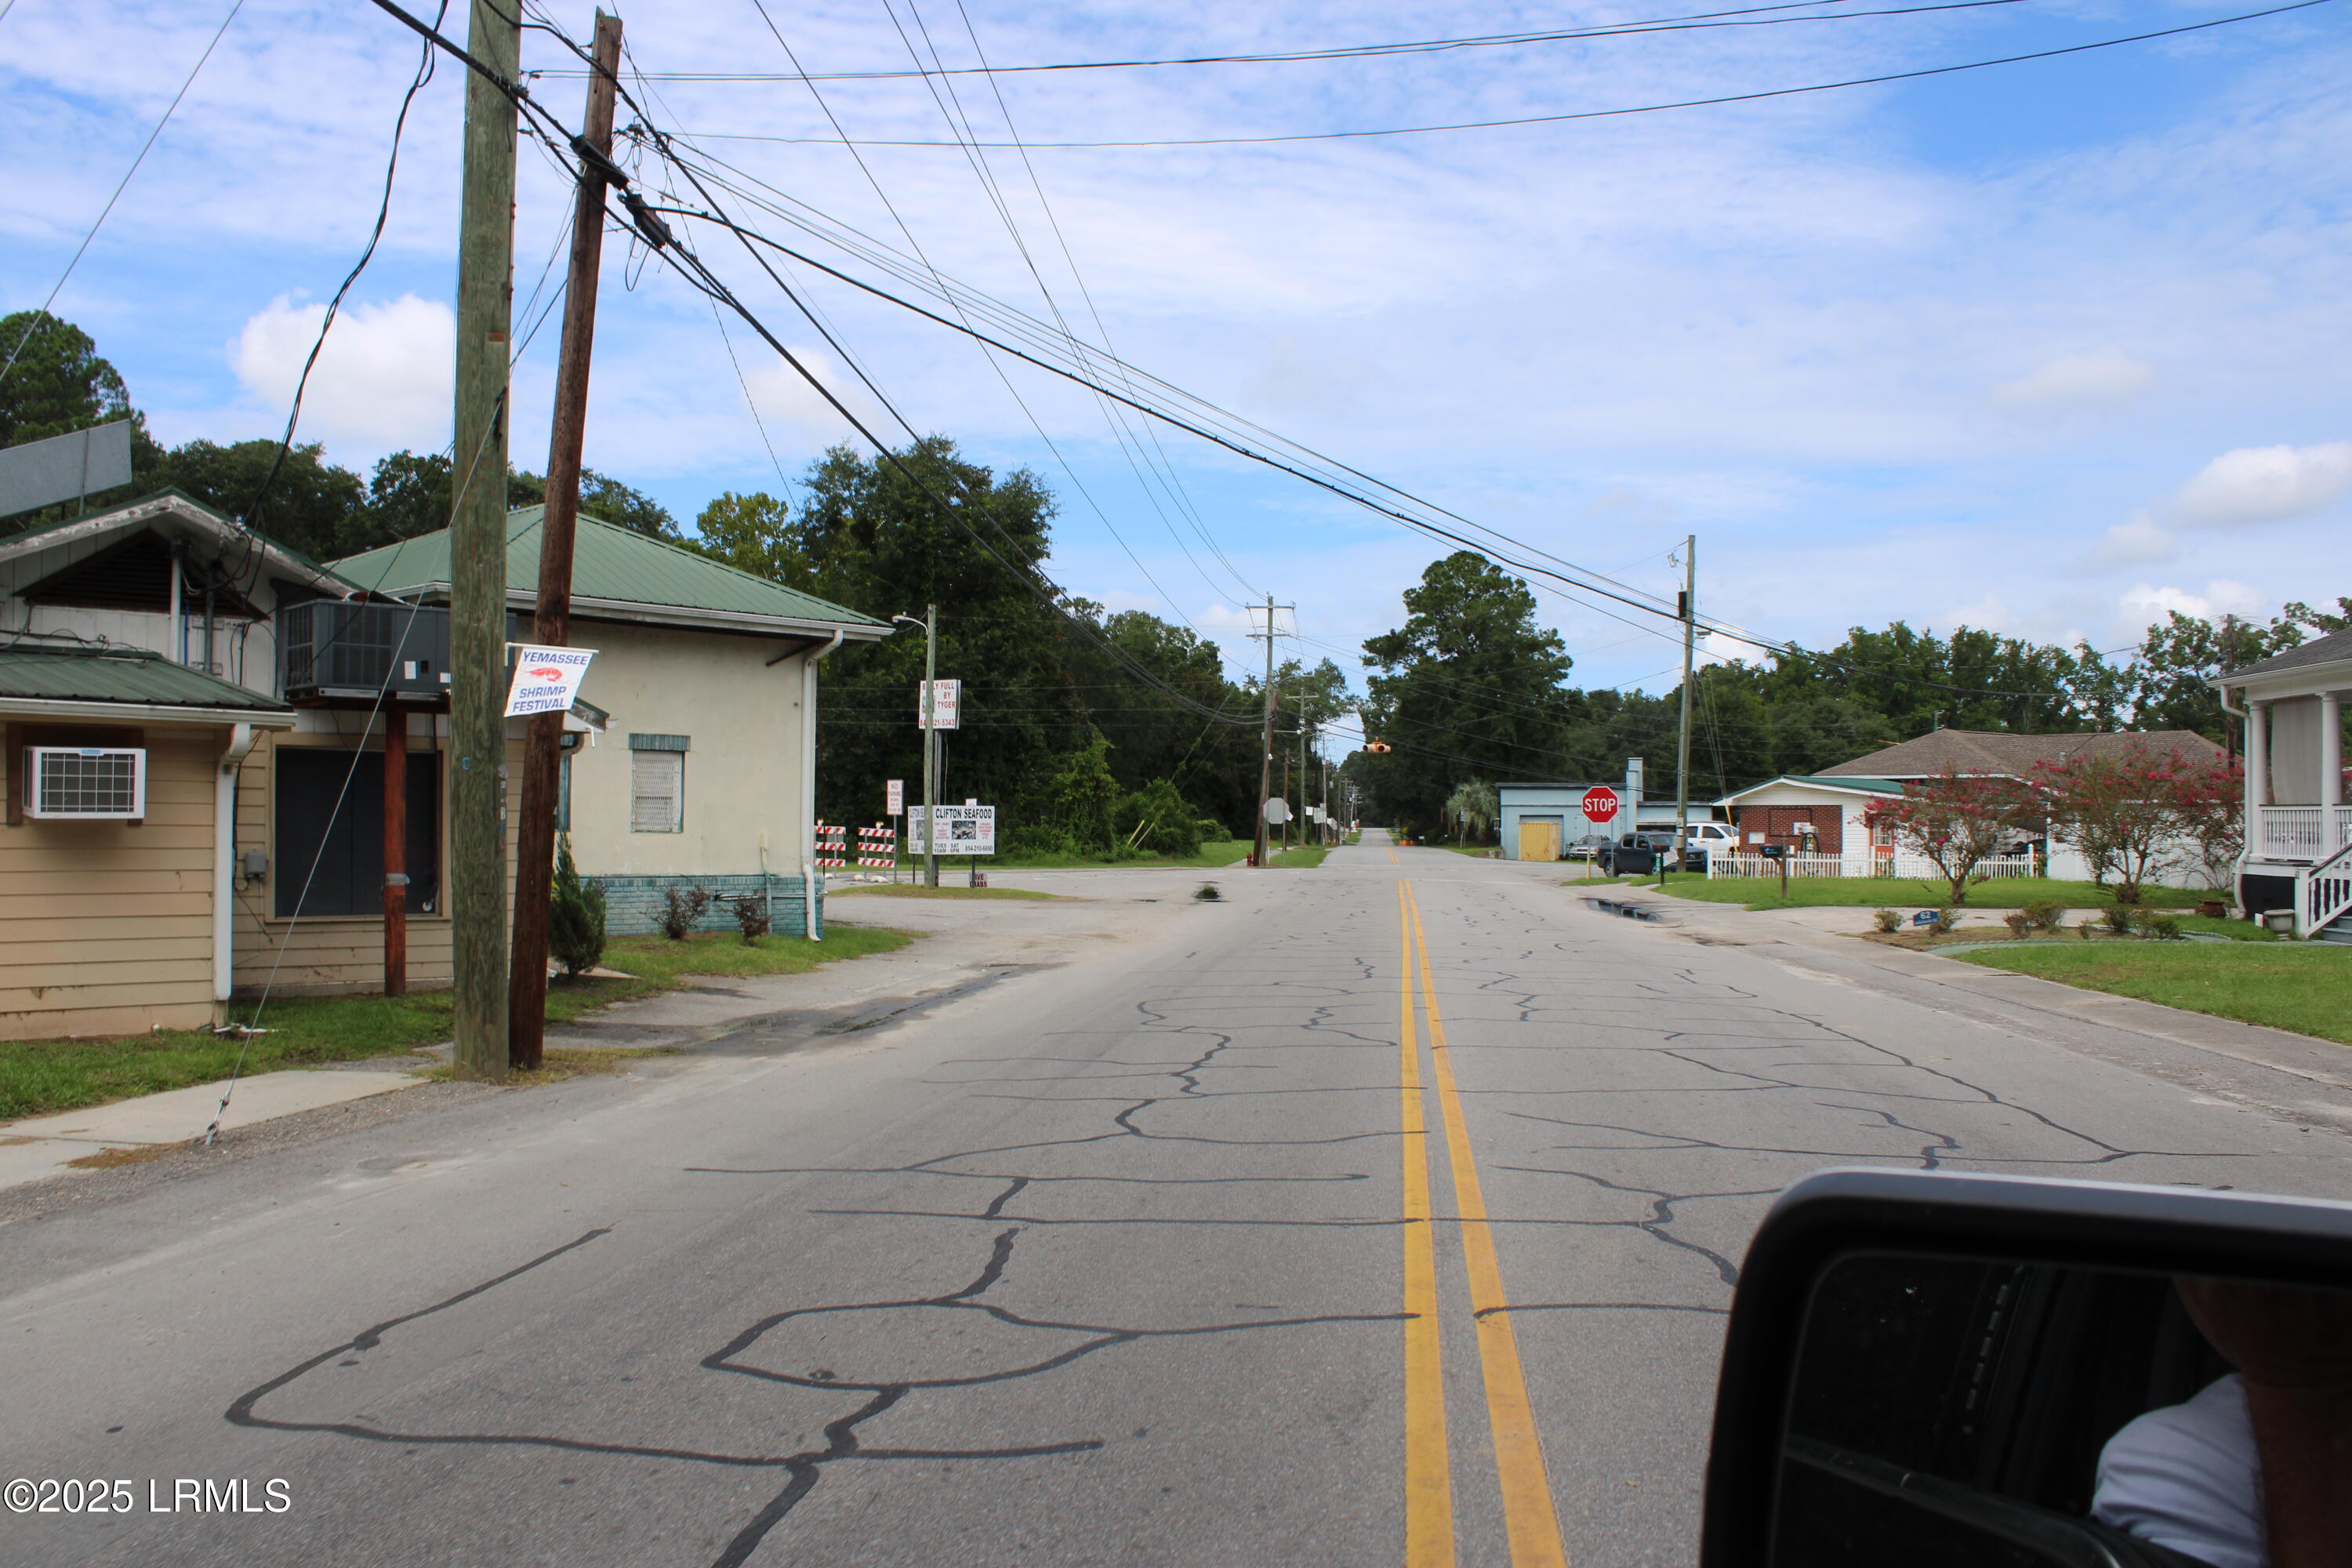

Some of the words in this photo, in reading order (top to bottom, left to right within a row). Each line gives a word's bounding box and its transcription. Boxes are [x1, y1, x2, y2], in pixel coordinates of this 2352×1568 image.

[523, 652, 589, 665] YEMASSEE
[519, 686, 566, 699] SHRIMP
[513, 698, 565, 712] FESTIVAL
[1584, 798, 1616, 812] STOP
[935, 808, 962, 818] CLIFTON
[964, 808, 993, 818] SEAFOOD
